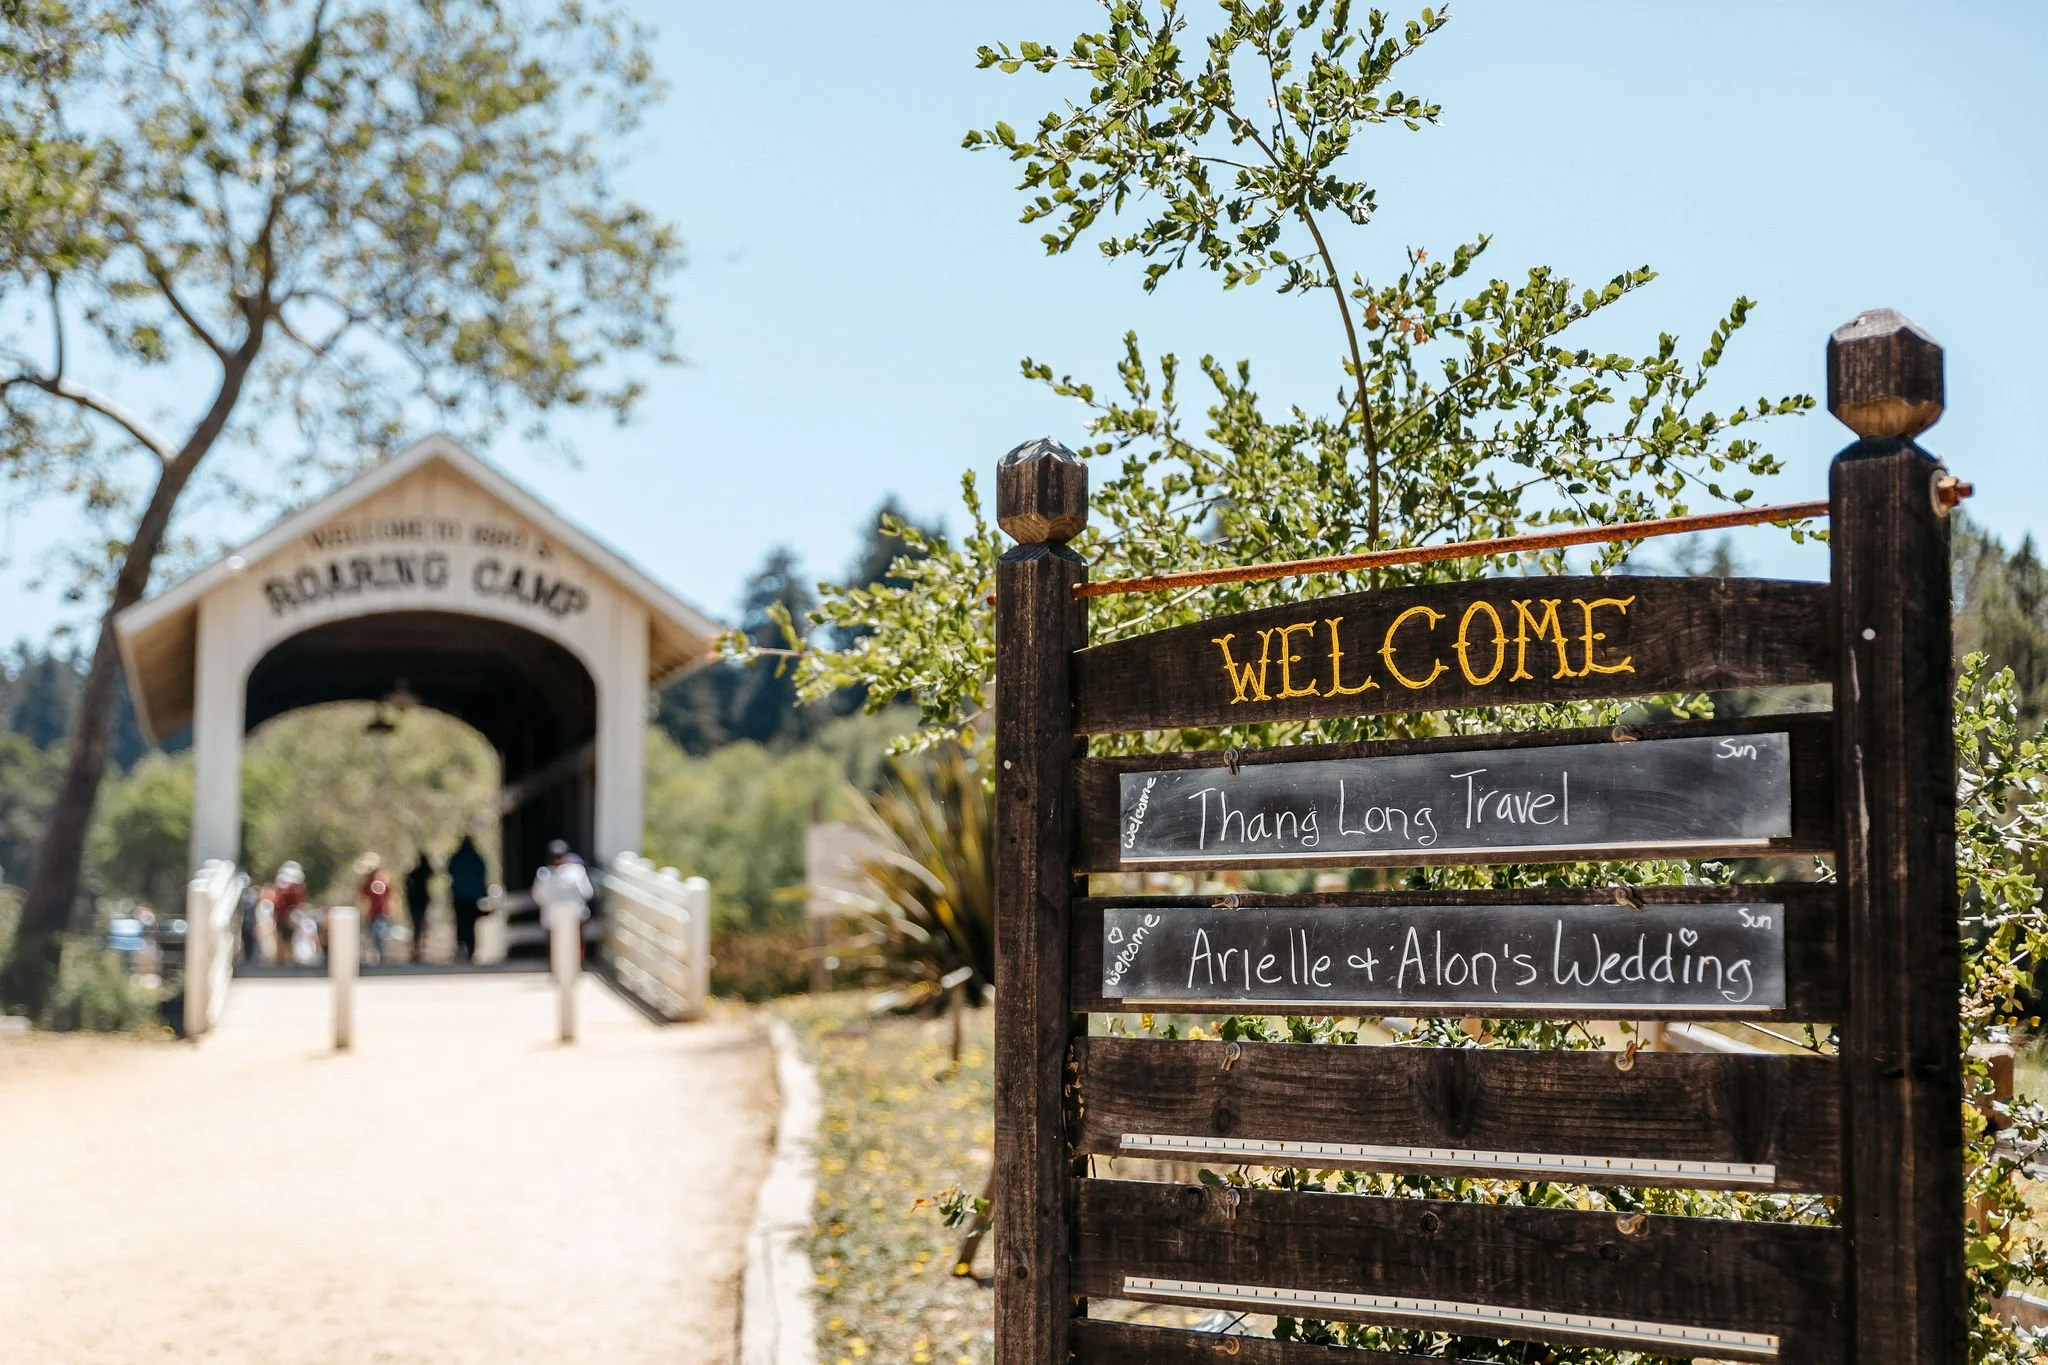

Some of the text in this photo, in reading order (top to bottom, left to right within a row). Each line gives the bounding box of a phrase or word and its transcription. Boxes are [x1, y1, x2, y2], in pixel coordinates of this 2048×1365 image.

[263, 551, 589, 617] ROARING CAMP
[1211, 595, 1636, 704] WELCOME
[1716, 738, 1758, 760] Sun
[1124, 776, 1157, 849] welcome
[1188, 768, 1569, 850] Thang Long Travel
[1105, 913, 1161, 986] welcome
[1737, 907, 1773, 929] Sun
[1397, 926, 1538, 994] Alon's
[1553, 919, 1753, 1003] Wedding
